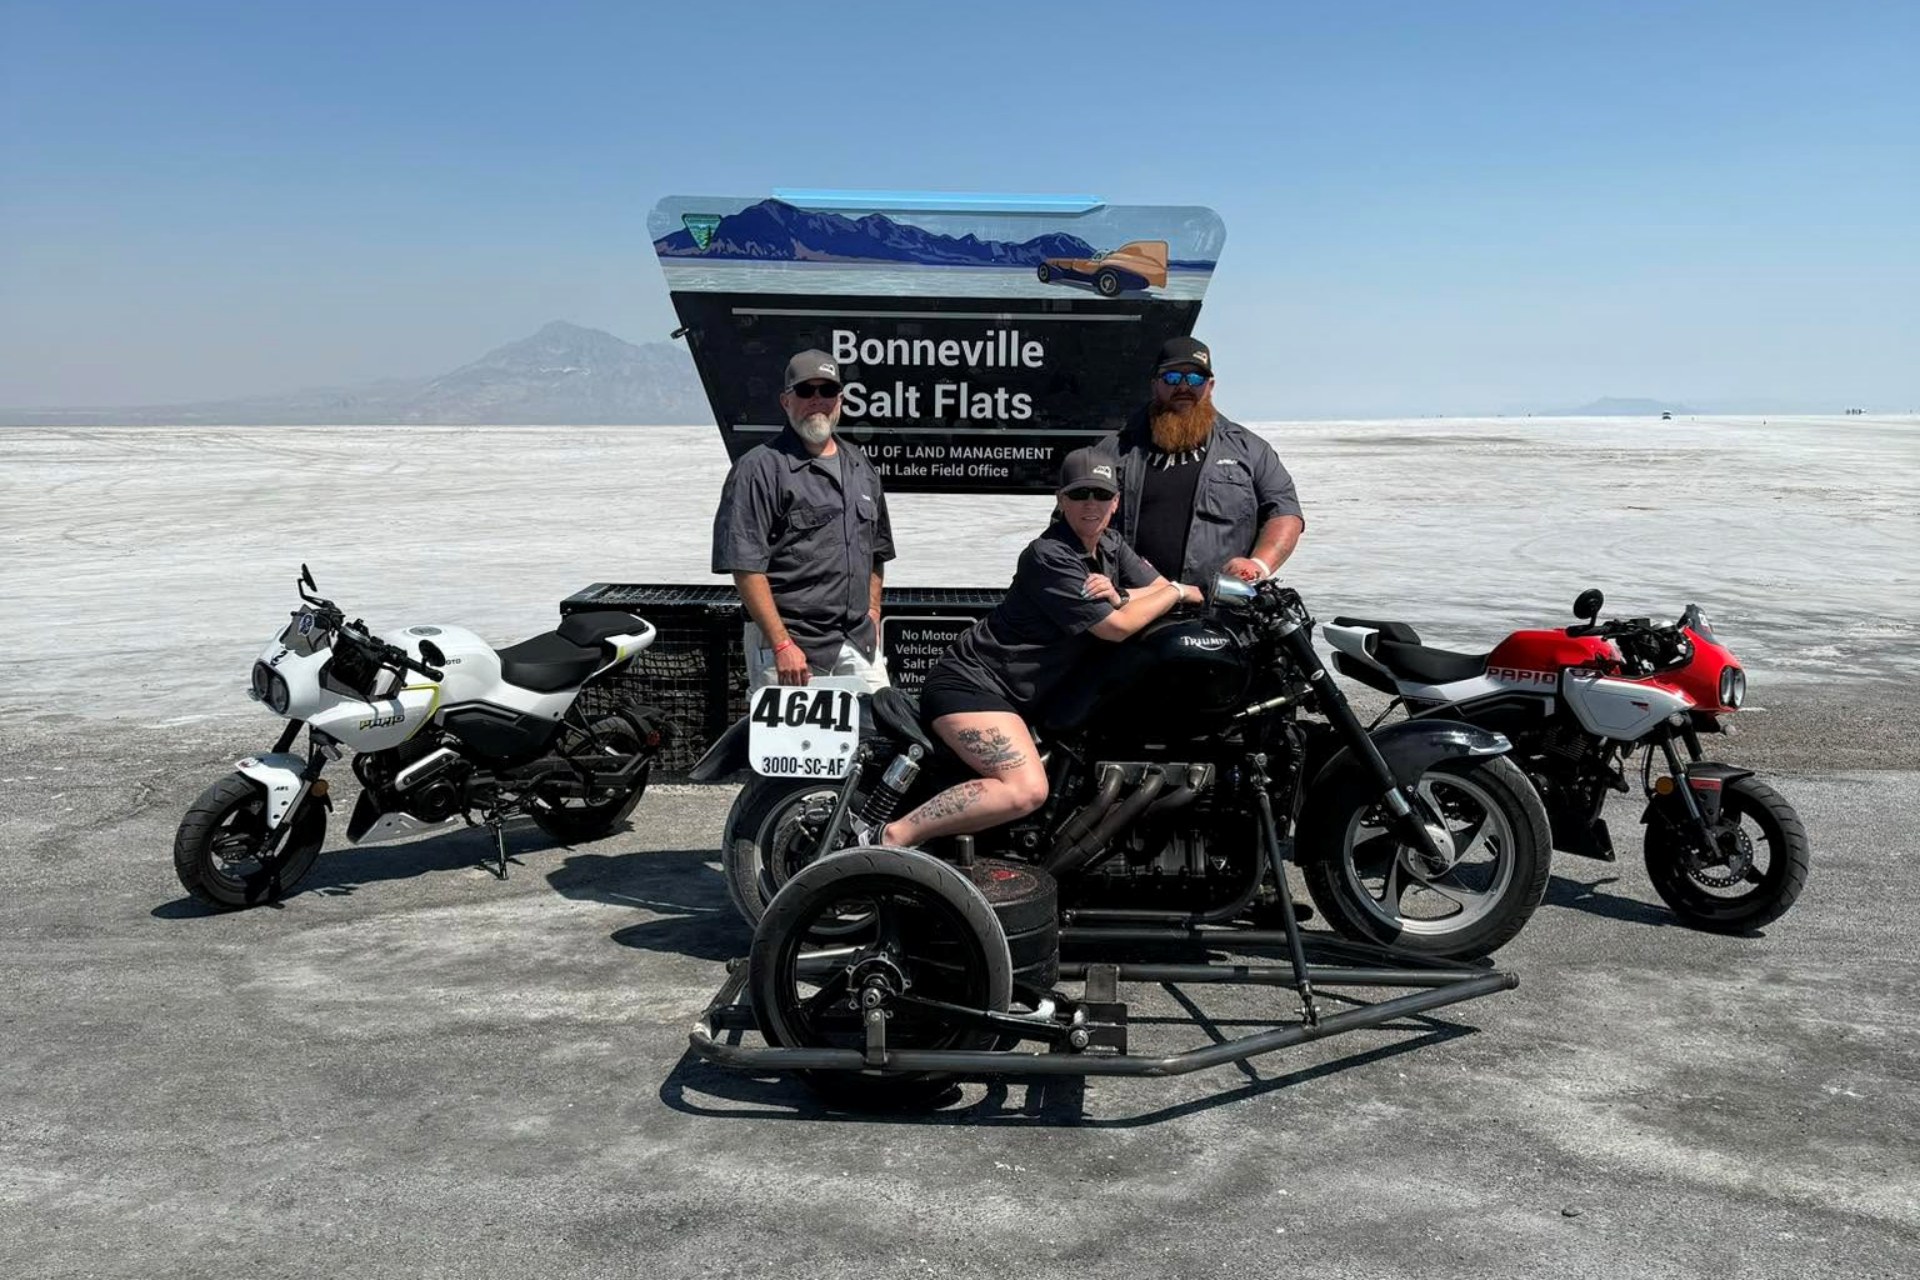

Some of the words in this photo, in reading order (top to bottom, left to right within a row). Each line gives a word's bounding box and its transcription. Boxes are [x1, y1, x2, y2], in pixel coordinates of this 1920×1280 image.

[832, 329, 1044, 368] Bonneville
[842, 380, 921, 419] Salt
[934, 381, 1032, 420] Flats
[883, 446, 902, 458] OF
[906, 446, 945, 459] LAND
[949, 447, 1054, 460] MANAGEMENT
[874, 463, 891, 476] alt
[895, 463, 927, 477] Lake
[931, 464, 964, 477] Field
[968, 464, 1009, 478] Office
[902, 629, 919, 640] No
[922, 629, 958, 641] Motor
[895, 643, 944, 655] Vehicles
[903, 658, 926, 669] Salt
[899, 672, 926, 684] Whe
[1486, 666, 1556, 685] PAPIO
[752, 688, 853, 732] 4641
[763, 757, 845, 776] 3000-SC-AF
